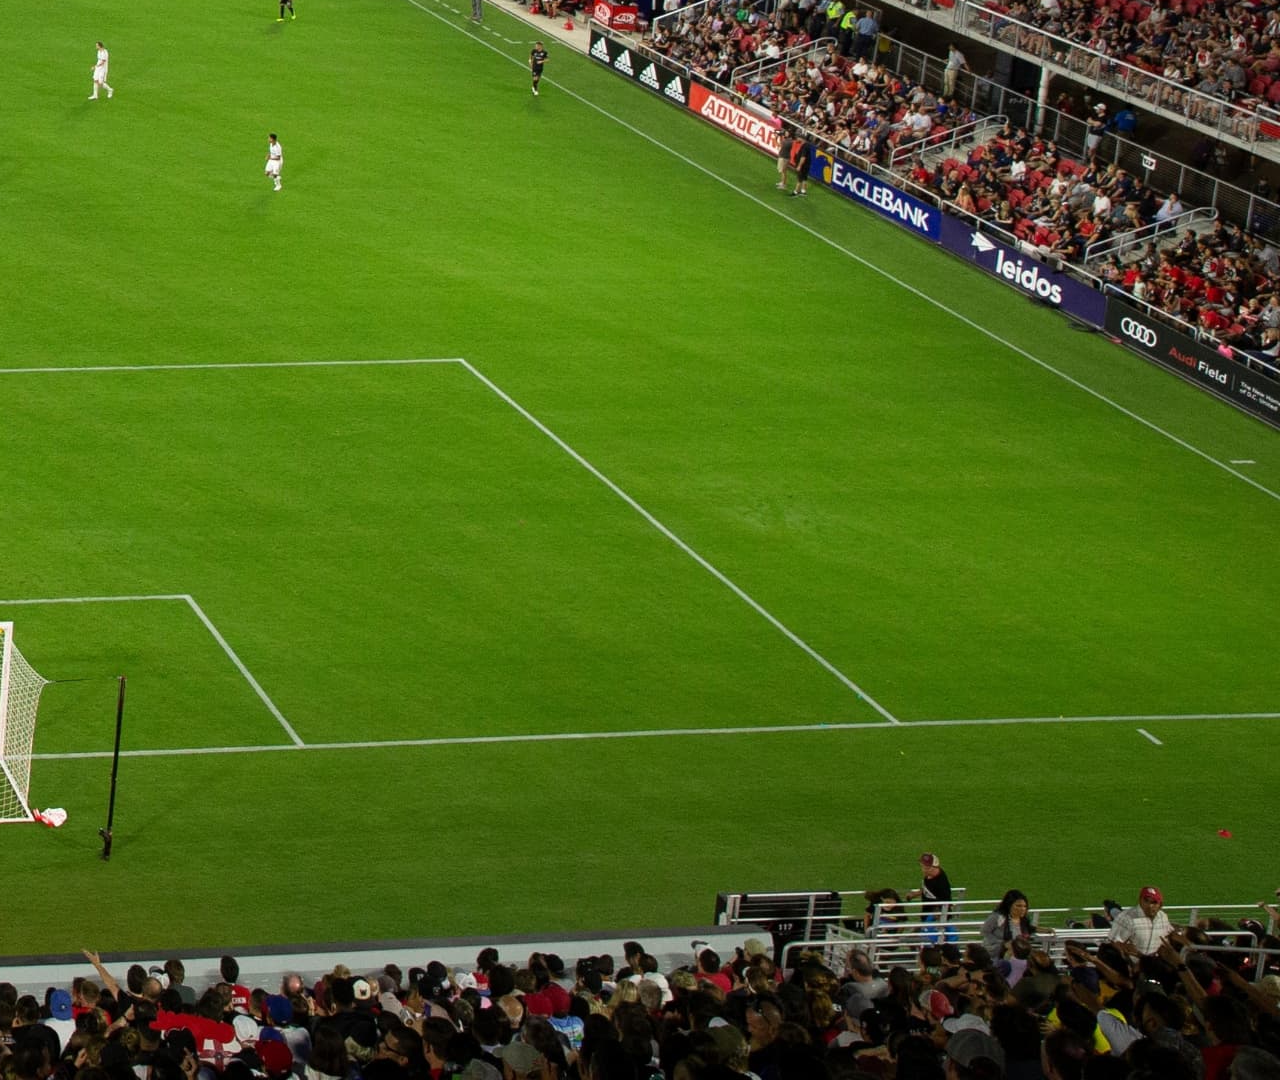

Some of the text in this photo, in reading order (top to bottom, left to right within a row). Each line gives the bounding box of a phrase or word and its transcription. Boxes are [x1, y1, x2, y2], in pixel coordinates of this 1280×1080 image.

[664, 86, 685, 103] adidas
[701, 95, 781, 155] ADVOCAR
[996, 250, 1062, 303] leidos
[1168, 347, 1227, 384] Audi Field
